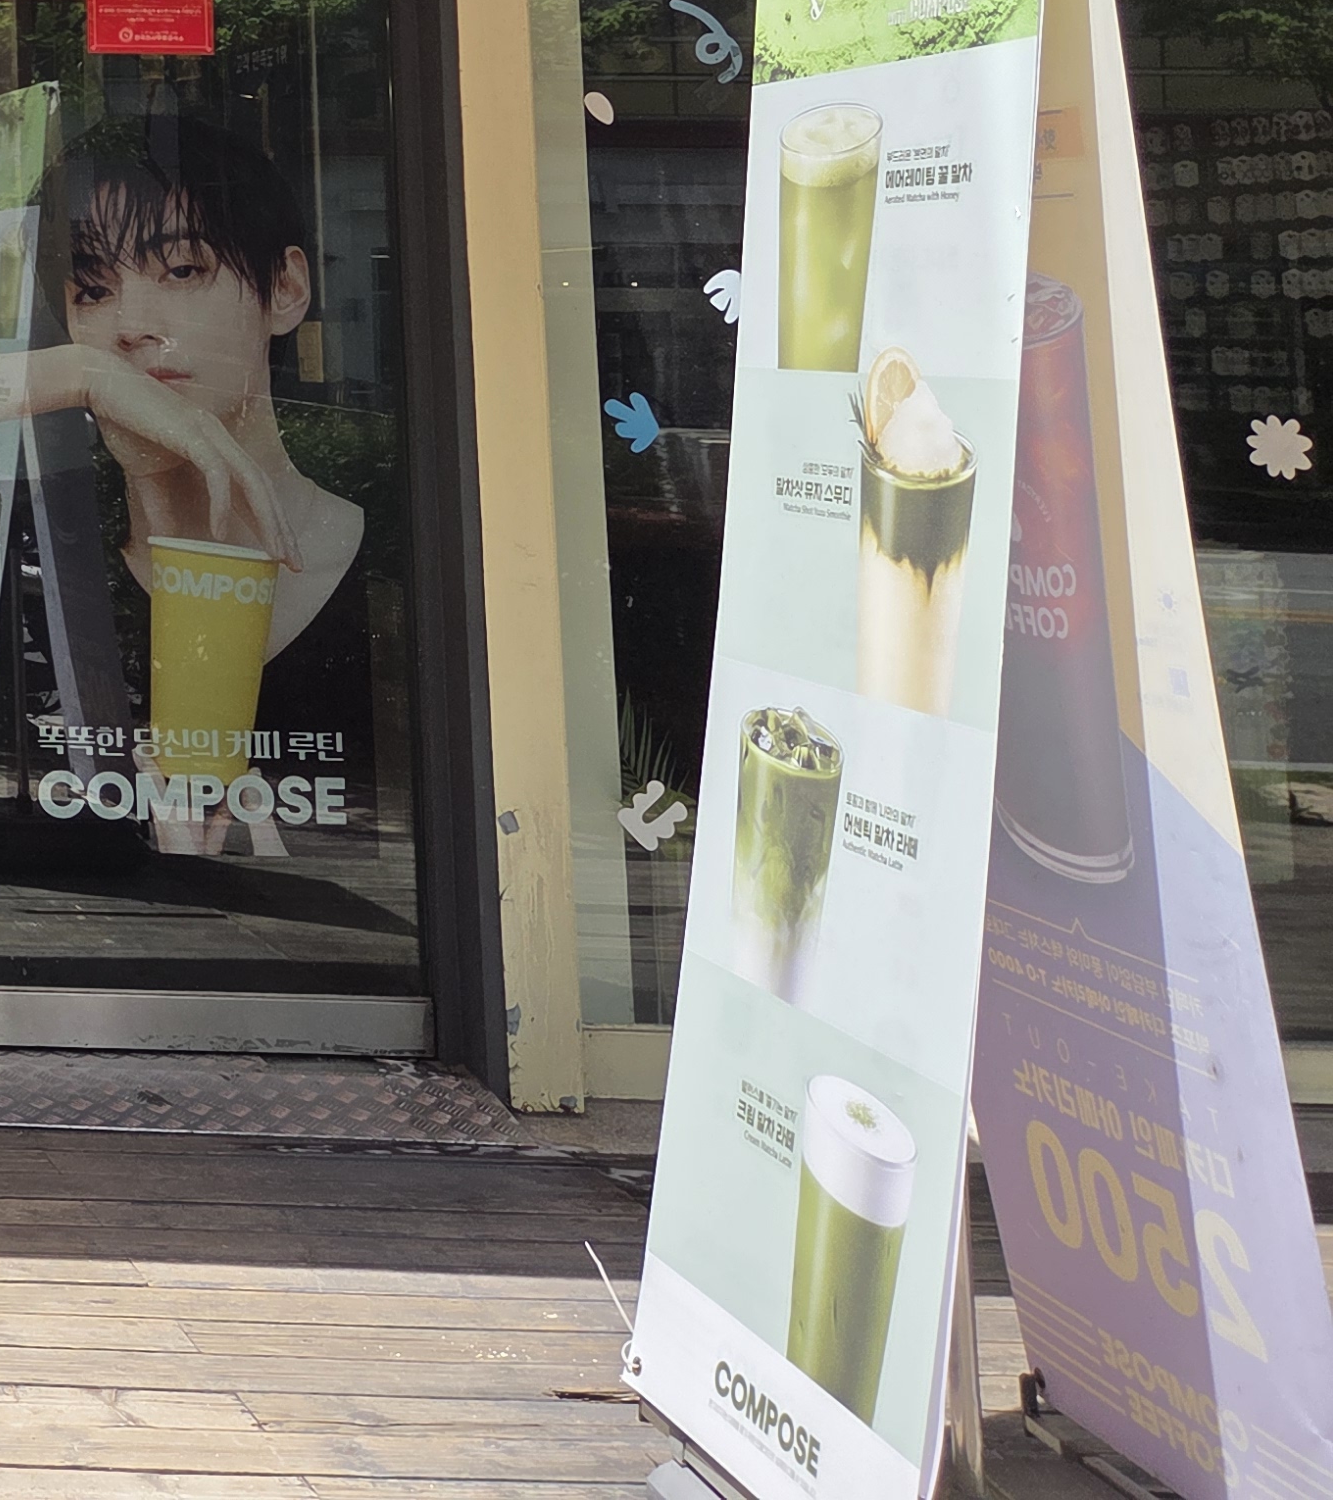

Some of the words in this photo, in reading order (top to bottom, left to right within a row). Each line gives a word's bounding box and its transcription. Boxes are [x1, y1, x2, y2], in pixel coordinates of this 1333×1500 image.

[886, 166, 935, 188] 에어레이팅
[951, 162, 972, 183] 말차
[805, 481, 822, 501] 유자
[824, 484, 852, 506] 스무디
[38, 726, 127, 757] 똑똑한
[133, 727, 219, 758] 당신의
[225, 730, 280, 760] 커피
[288, 731, 344, 762] 루틴
[38, 770, 347, 825] COMPOSE
[874, 824, 895, 851] 말차
[715, 1361, 820, 1479] COMPOSE
